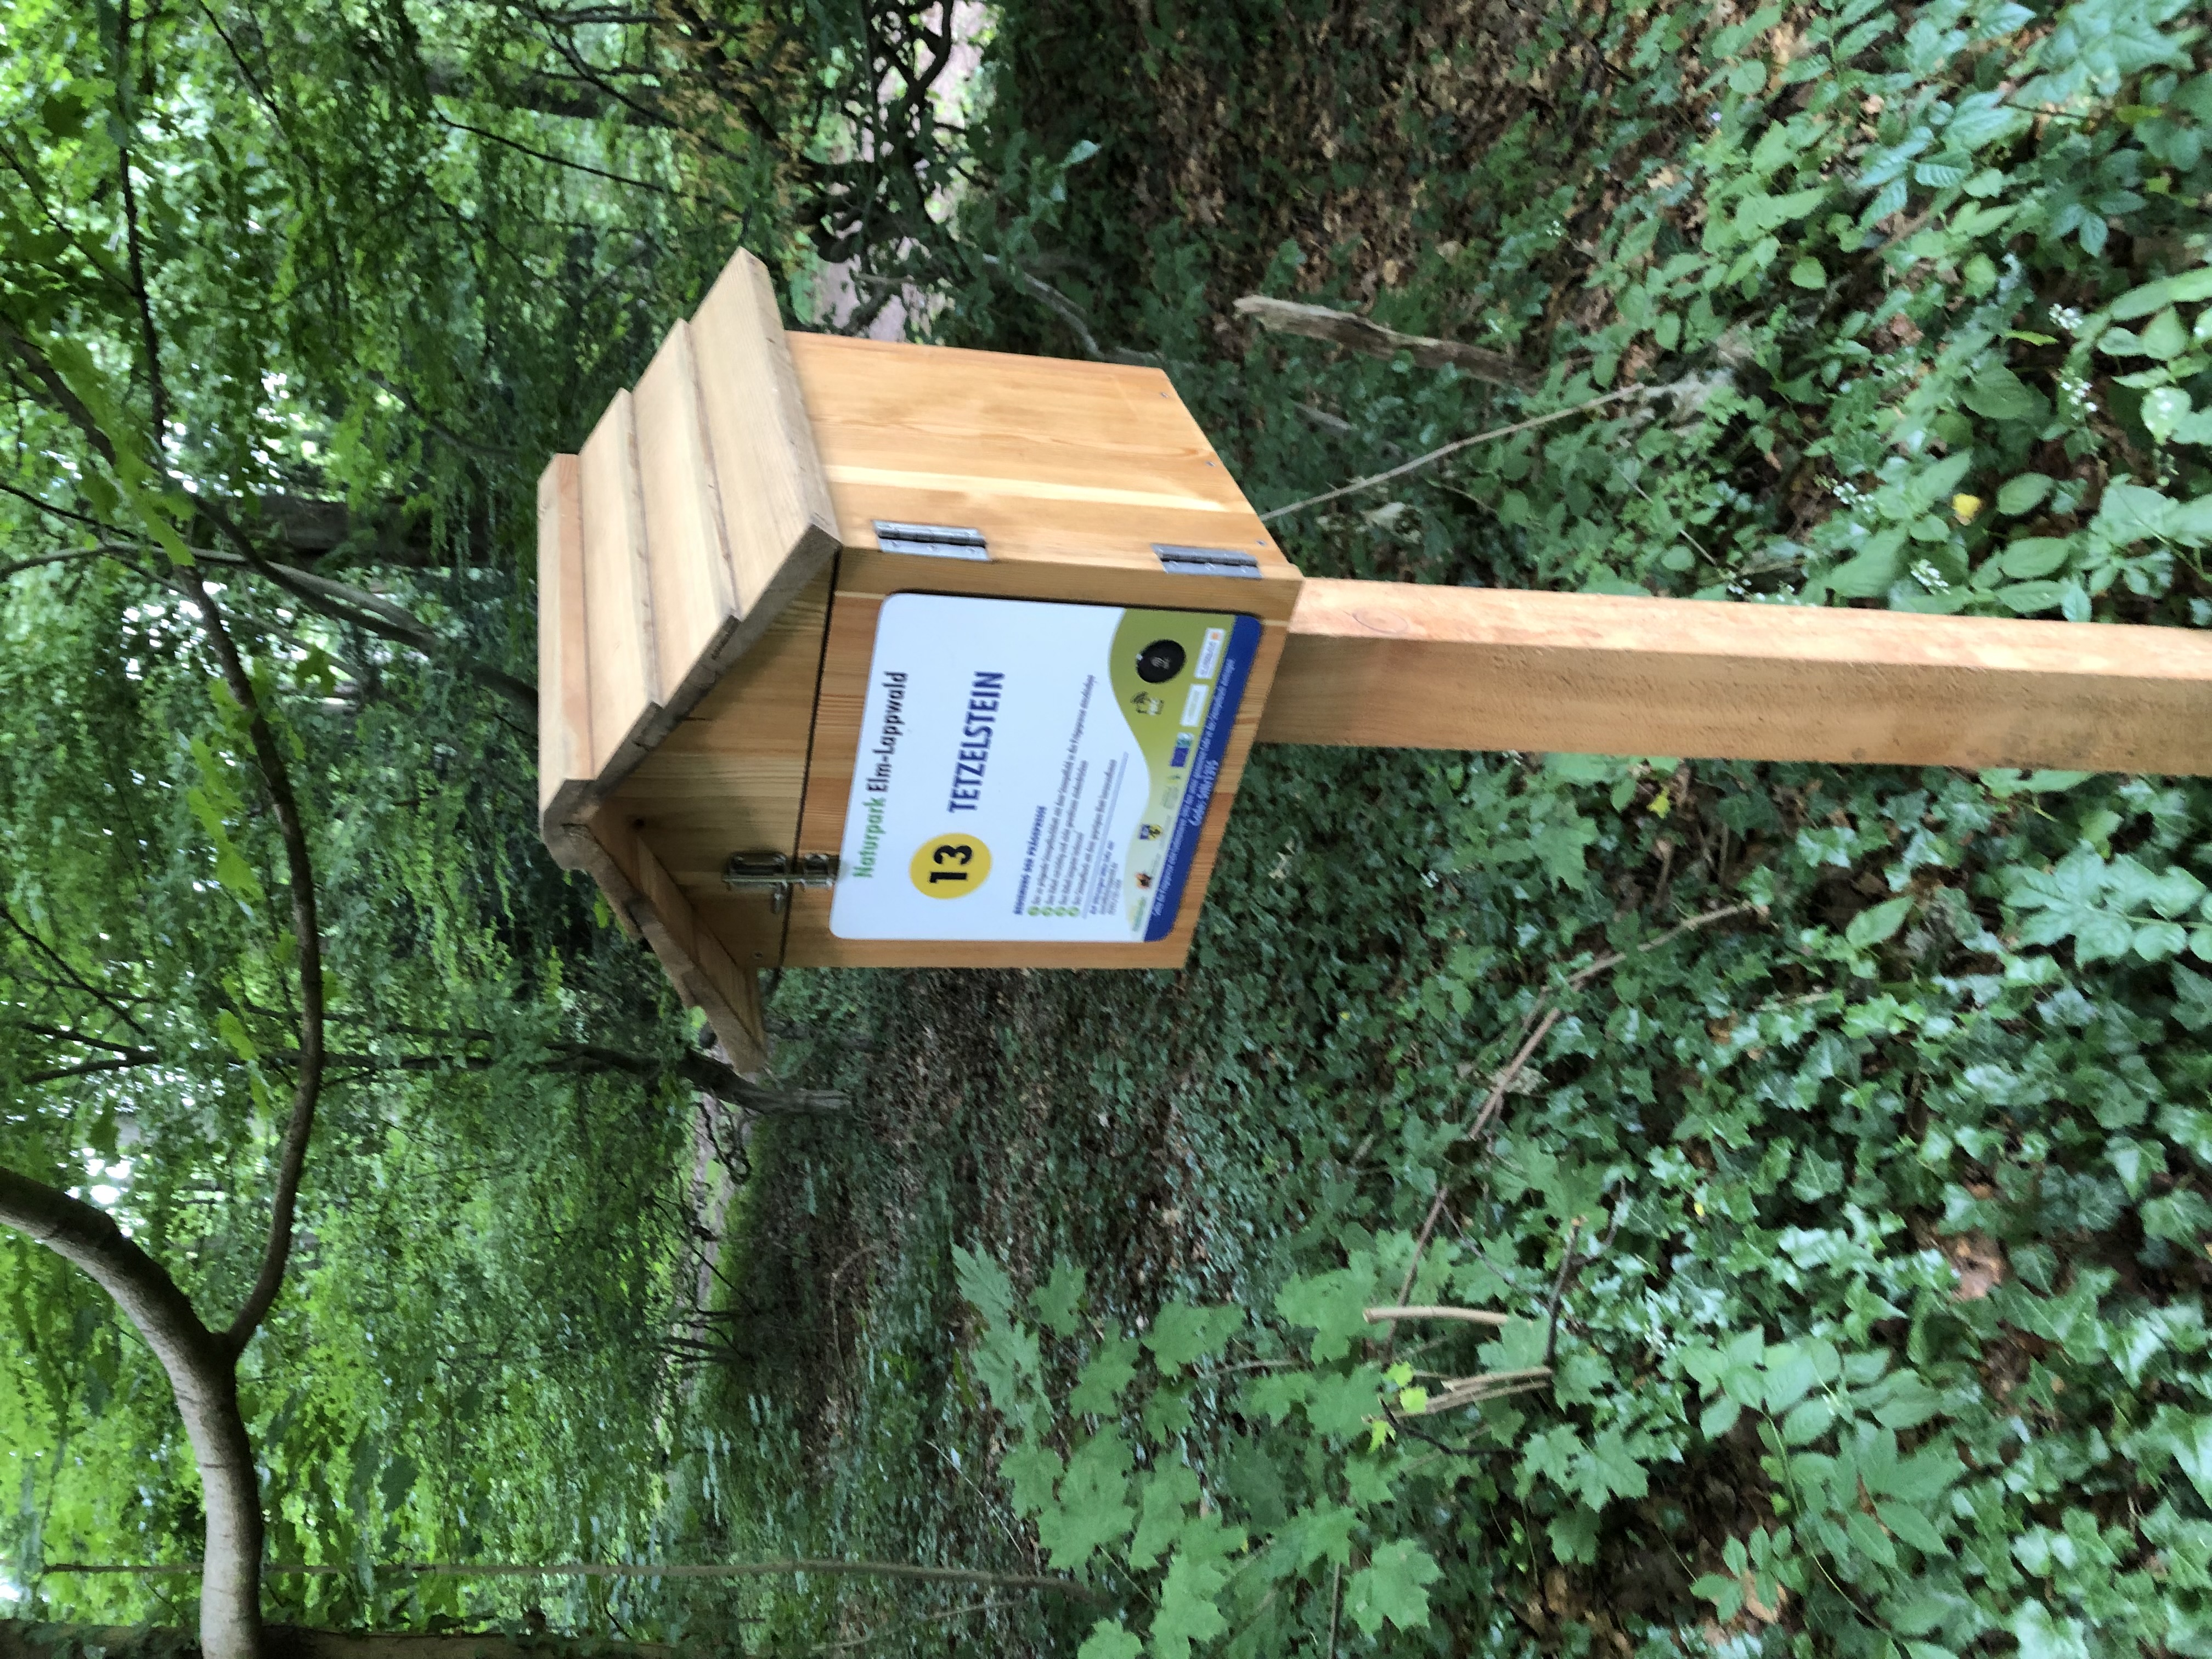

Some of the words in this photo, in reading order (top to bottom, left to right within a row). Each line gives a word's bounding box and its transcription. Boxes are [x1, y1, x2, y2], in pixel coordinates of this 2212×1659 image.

[867, 672, 907, 792] Elm-Lappwald
[948, 672, 1004, 812] TETZELSTEIN
[851, 797, 885, 877] Naturpark
[929, 845, 972, 883] 13
